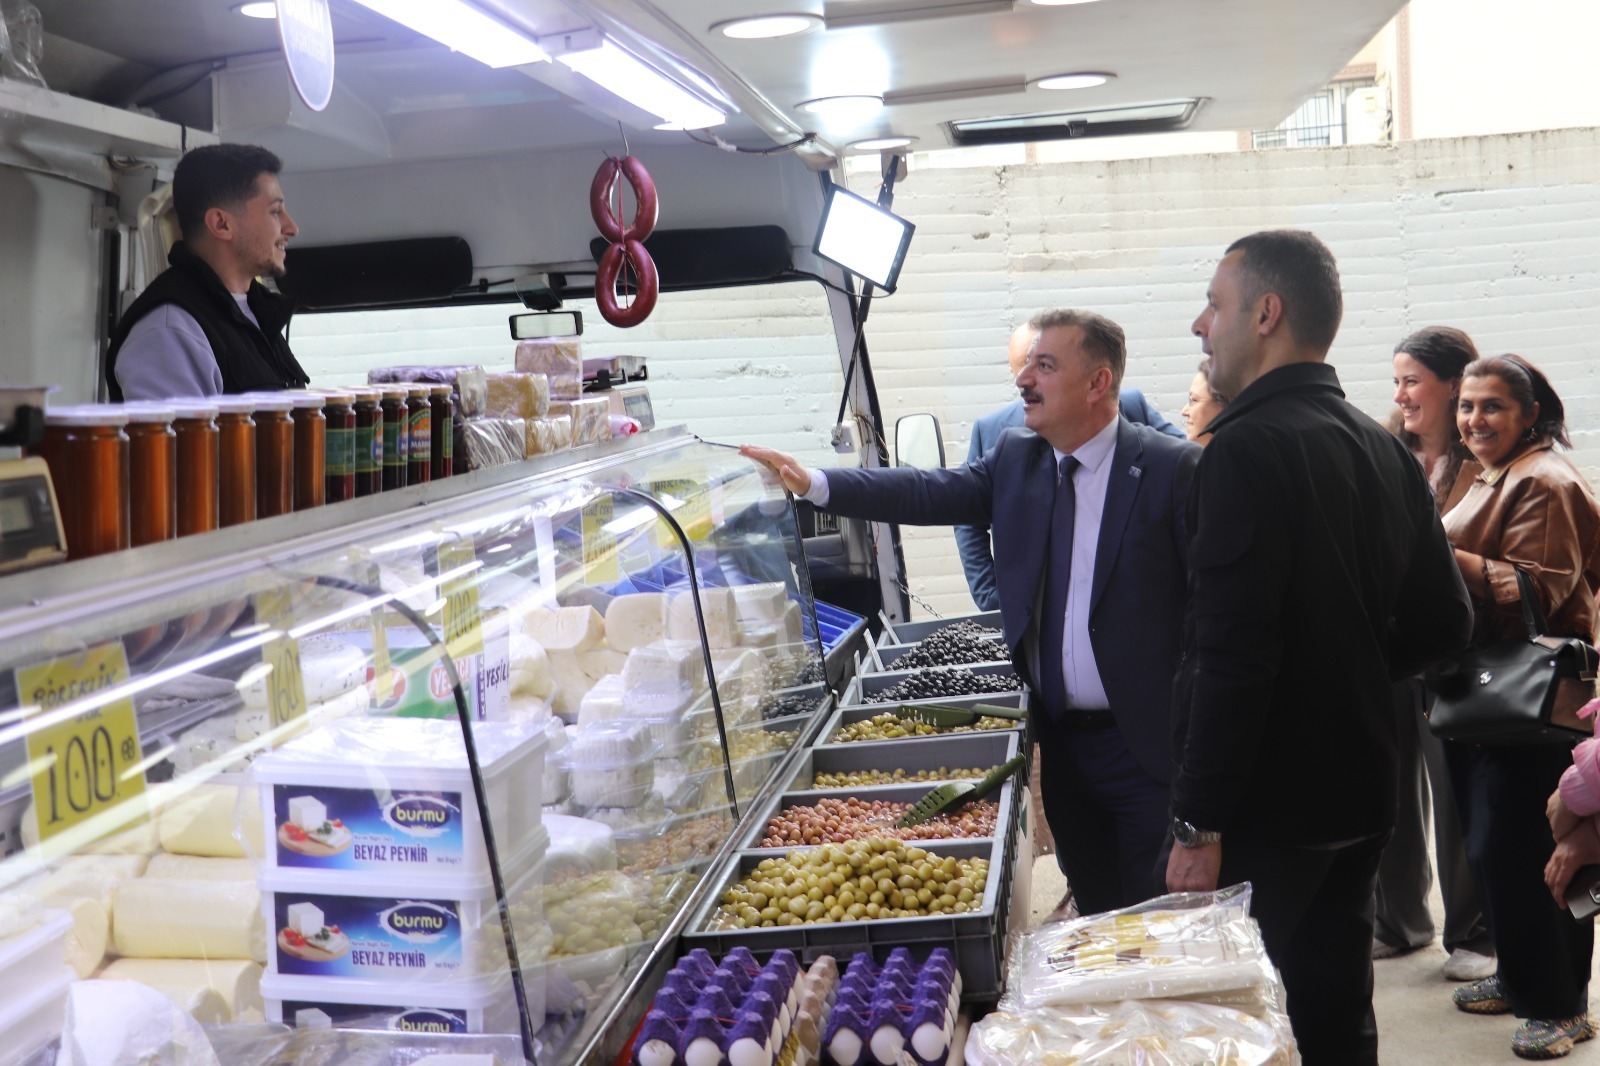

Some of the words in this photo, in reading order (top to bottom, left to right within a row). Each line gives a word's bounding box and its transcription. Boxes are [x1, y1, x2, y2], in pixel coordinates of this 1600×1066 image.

[396, 805, 446, 823] burmu
[354, 844, 387, 862] BEYAZ
[390, 843, 428, 863] PEYNİR
[393, 912, 443, 929] burmu
[352, 950, 385, 966] BEYAZ
[388, 949, 426, 968] PEYNİR
[401, 1018, 451, 1033] burmu
